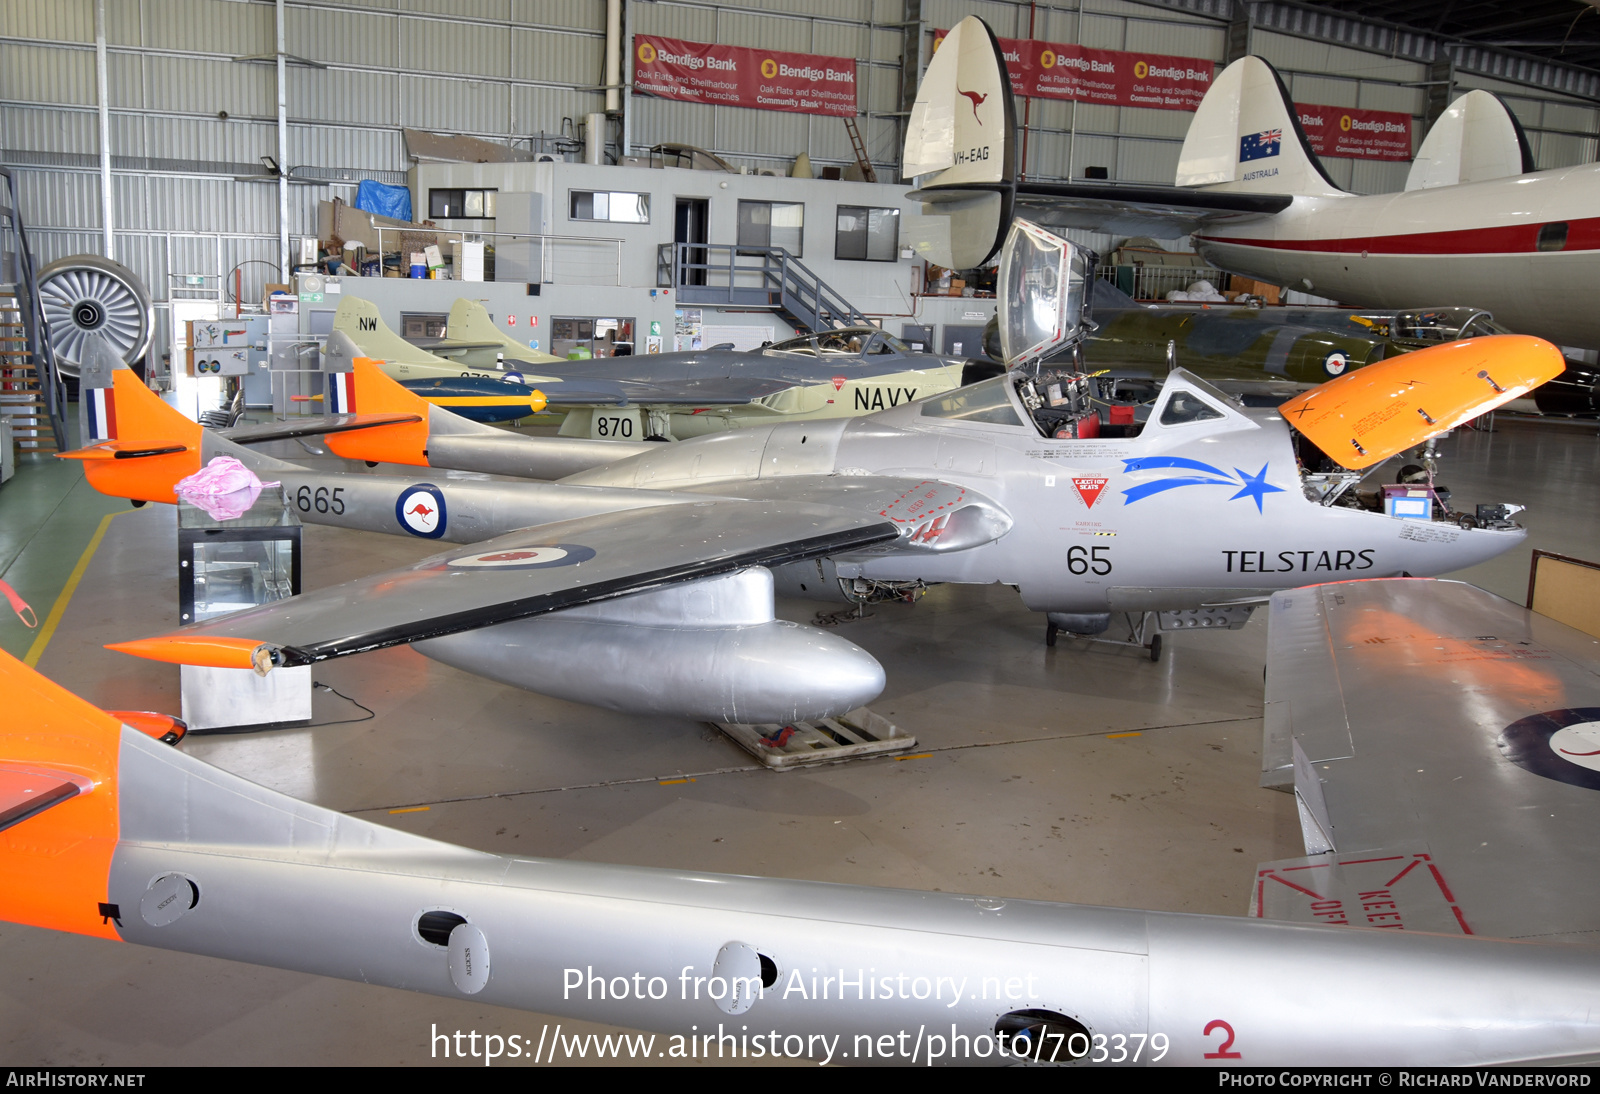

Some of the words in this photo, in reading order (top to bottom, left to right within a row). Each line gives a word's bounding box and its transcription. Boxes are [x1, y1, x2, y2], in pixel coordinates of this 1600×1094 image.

[657, 49, 704, 70] Bendigo
[706, 56, 737, 71] Bank
[1002, 51, 1020, 62] ank
[779, 64, 824, 81] Bendigo
[826, 68, 854, 83] Bank
[1091, 60, 1115, 73] Bank
[1149, 65, 1185, 81] Bendigo
[1186, 69, 1209, 82] Bank
[637, 69, 652, 79] Oak
[654, 71, 673, 81] Flats
[675, 76, 688, 84] and
[691, 77, 738, 90] Shellharbour
[1039, 74, 1052, 82] Oak
[634, 80, 678, 94] Community
[705, 90, 740, 101] branches
[760, 84, 774, 93] Oak
[776, 86, 793, 95] Flats
[811, 89, 855, 101] Shellharbour
[1036, 84, 1074, 95] Community
[1091, 90, 1118, 100] branches
[1133, 84, 1144, 92] Oak
[1146, 85, 1160, 94] Flats
[1162, 87, 1173, 95] and
[756, 95, 798, 107] Community
[824, 102, 857, 112] branches
[1130, 94, 1163, 104] Community
[1302, 114, 1324, 126] Bank
[1352, 119, 1384, 133] Bendigo
[1385, 122, 1406, 133] Bank
[953, 146, 989, 166] VH-EAG
[1243, 167, 1279, 181] AUSTRALIA
[360, 317, 377, 331] NW
[855, 387, 917, 410] NAVY
[598, 416, 632, 438] 870
[907, 499, 925, 514] KEEP
[924, 488, 939, 499] OFF
[1067, 545, 1113, 576] 65
[1222, 549, 1376, 573] TELSTARS
[157, 893, 177, 910] ACCESS
[1358, 890, 1404, 930] KEE
[1310, 900, 1349, 926] OF
